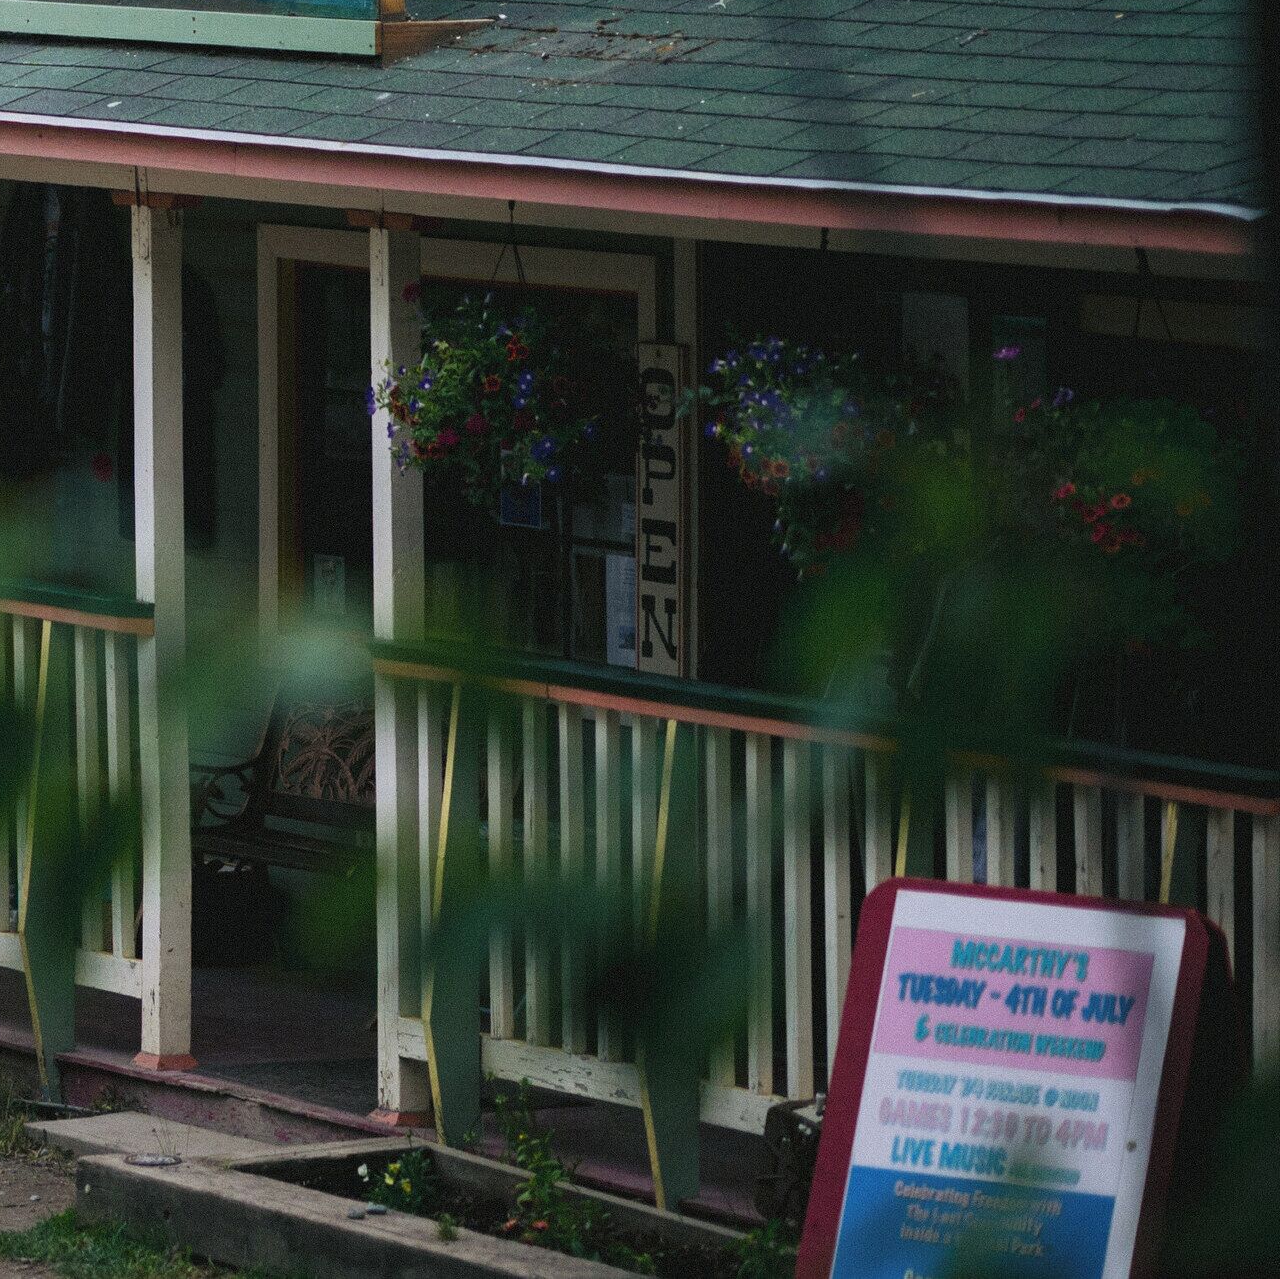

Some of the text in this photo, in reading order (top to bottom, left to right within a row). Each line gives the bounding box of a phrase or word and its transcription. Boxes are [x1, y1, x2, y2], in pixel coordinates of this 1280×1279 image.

[640, 367, 678, 660] OPEN
[951, 939, 1090, 981] MCCARTHY'S
[898, 972, 987, 1008] TUESDAY
[1005, 983, 1048, 1018] 4TH
[1051, 988, 1080, 1019] OF
[1081, 992, 1136, 1026] JULY
[890, 1136, 933, 1167] LIVE
[938, 1142, 1007, 1177] MUSIC
